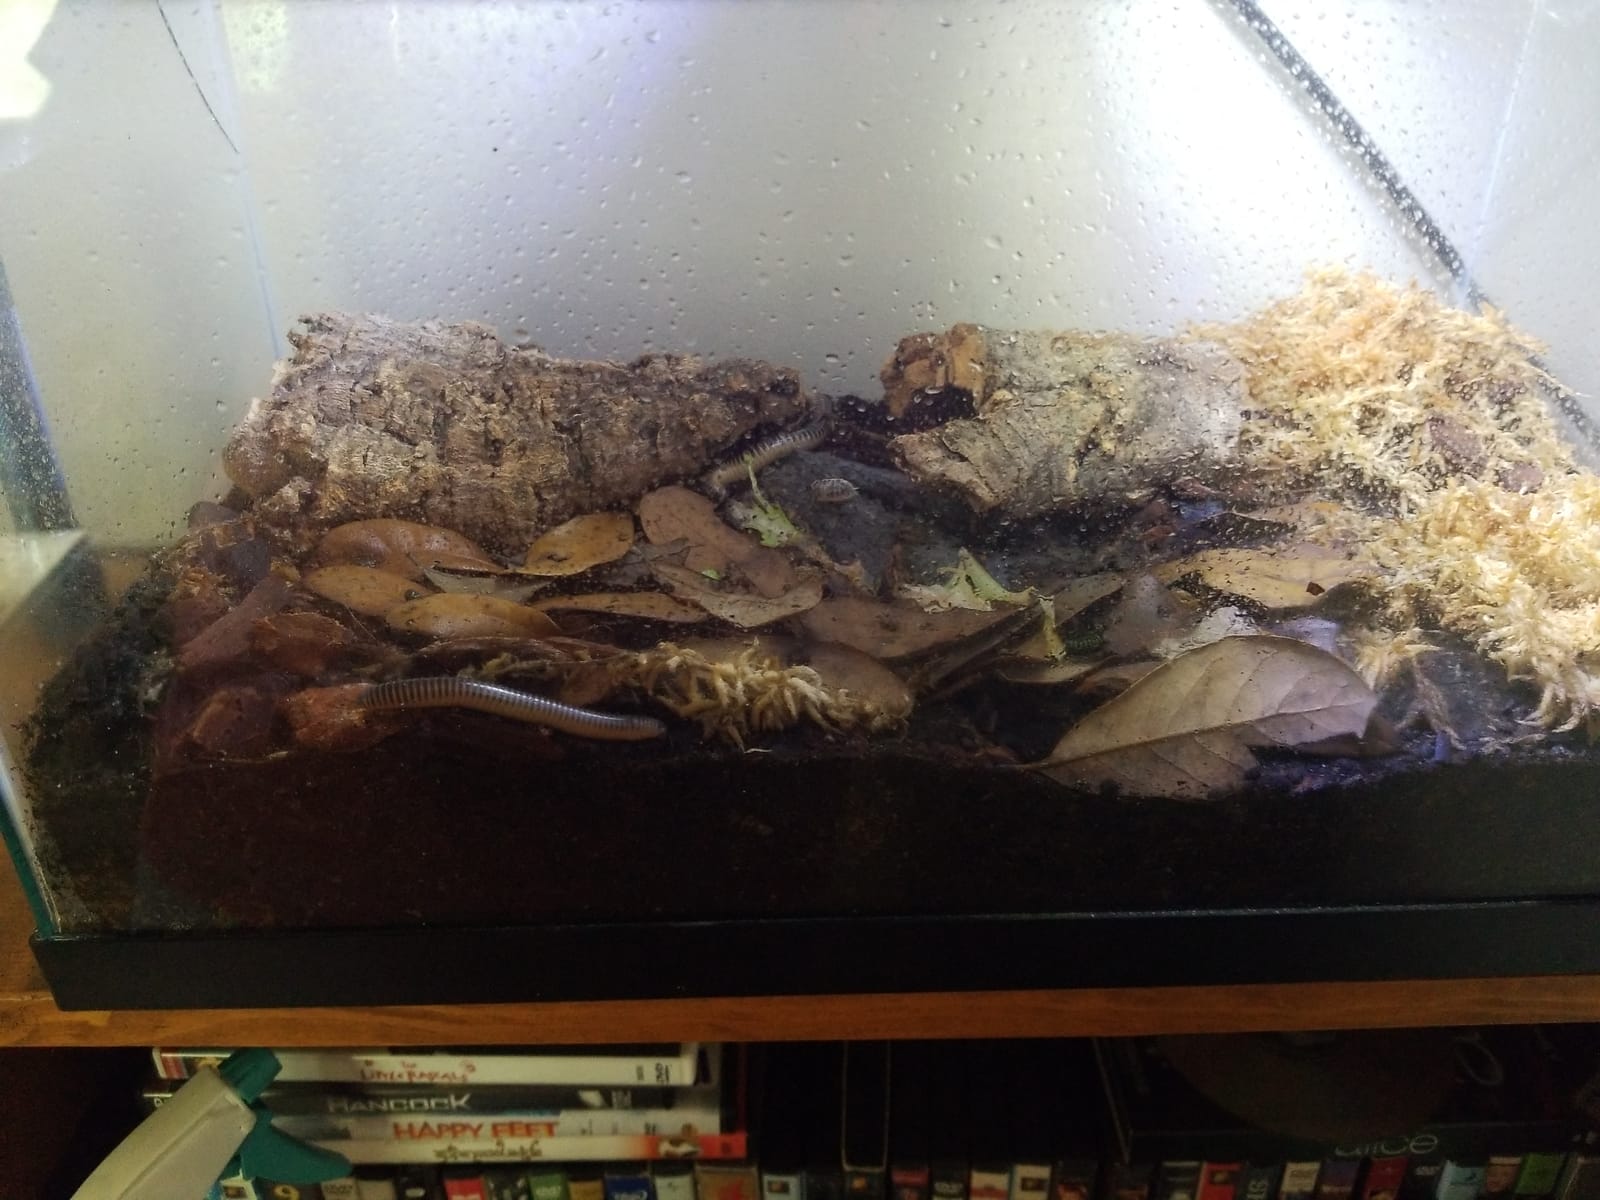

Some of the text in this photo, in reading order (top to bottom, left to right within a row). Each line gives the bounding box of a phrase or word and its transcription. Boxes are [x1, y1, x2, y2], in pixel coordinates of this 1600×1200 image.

[327, 1094, 470, 1112] HANCOCK
[393, 1120, 559, 1139] HAPPY FEET
